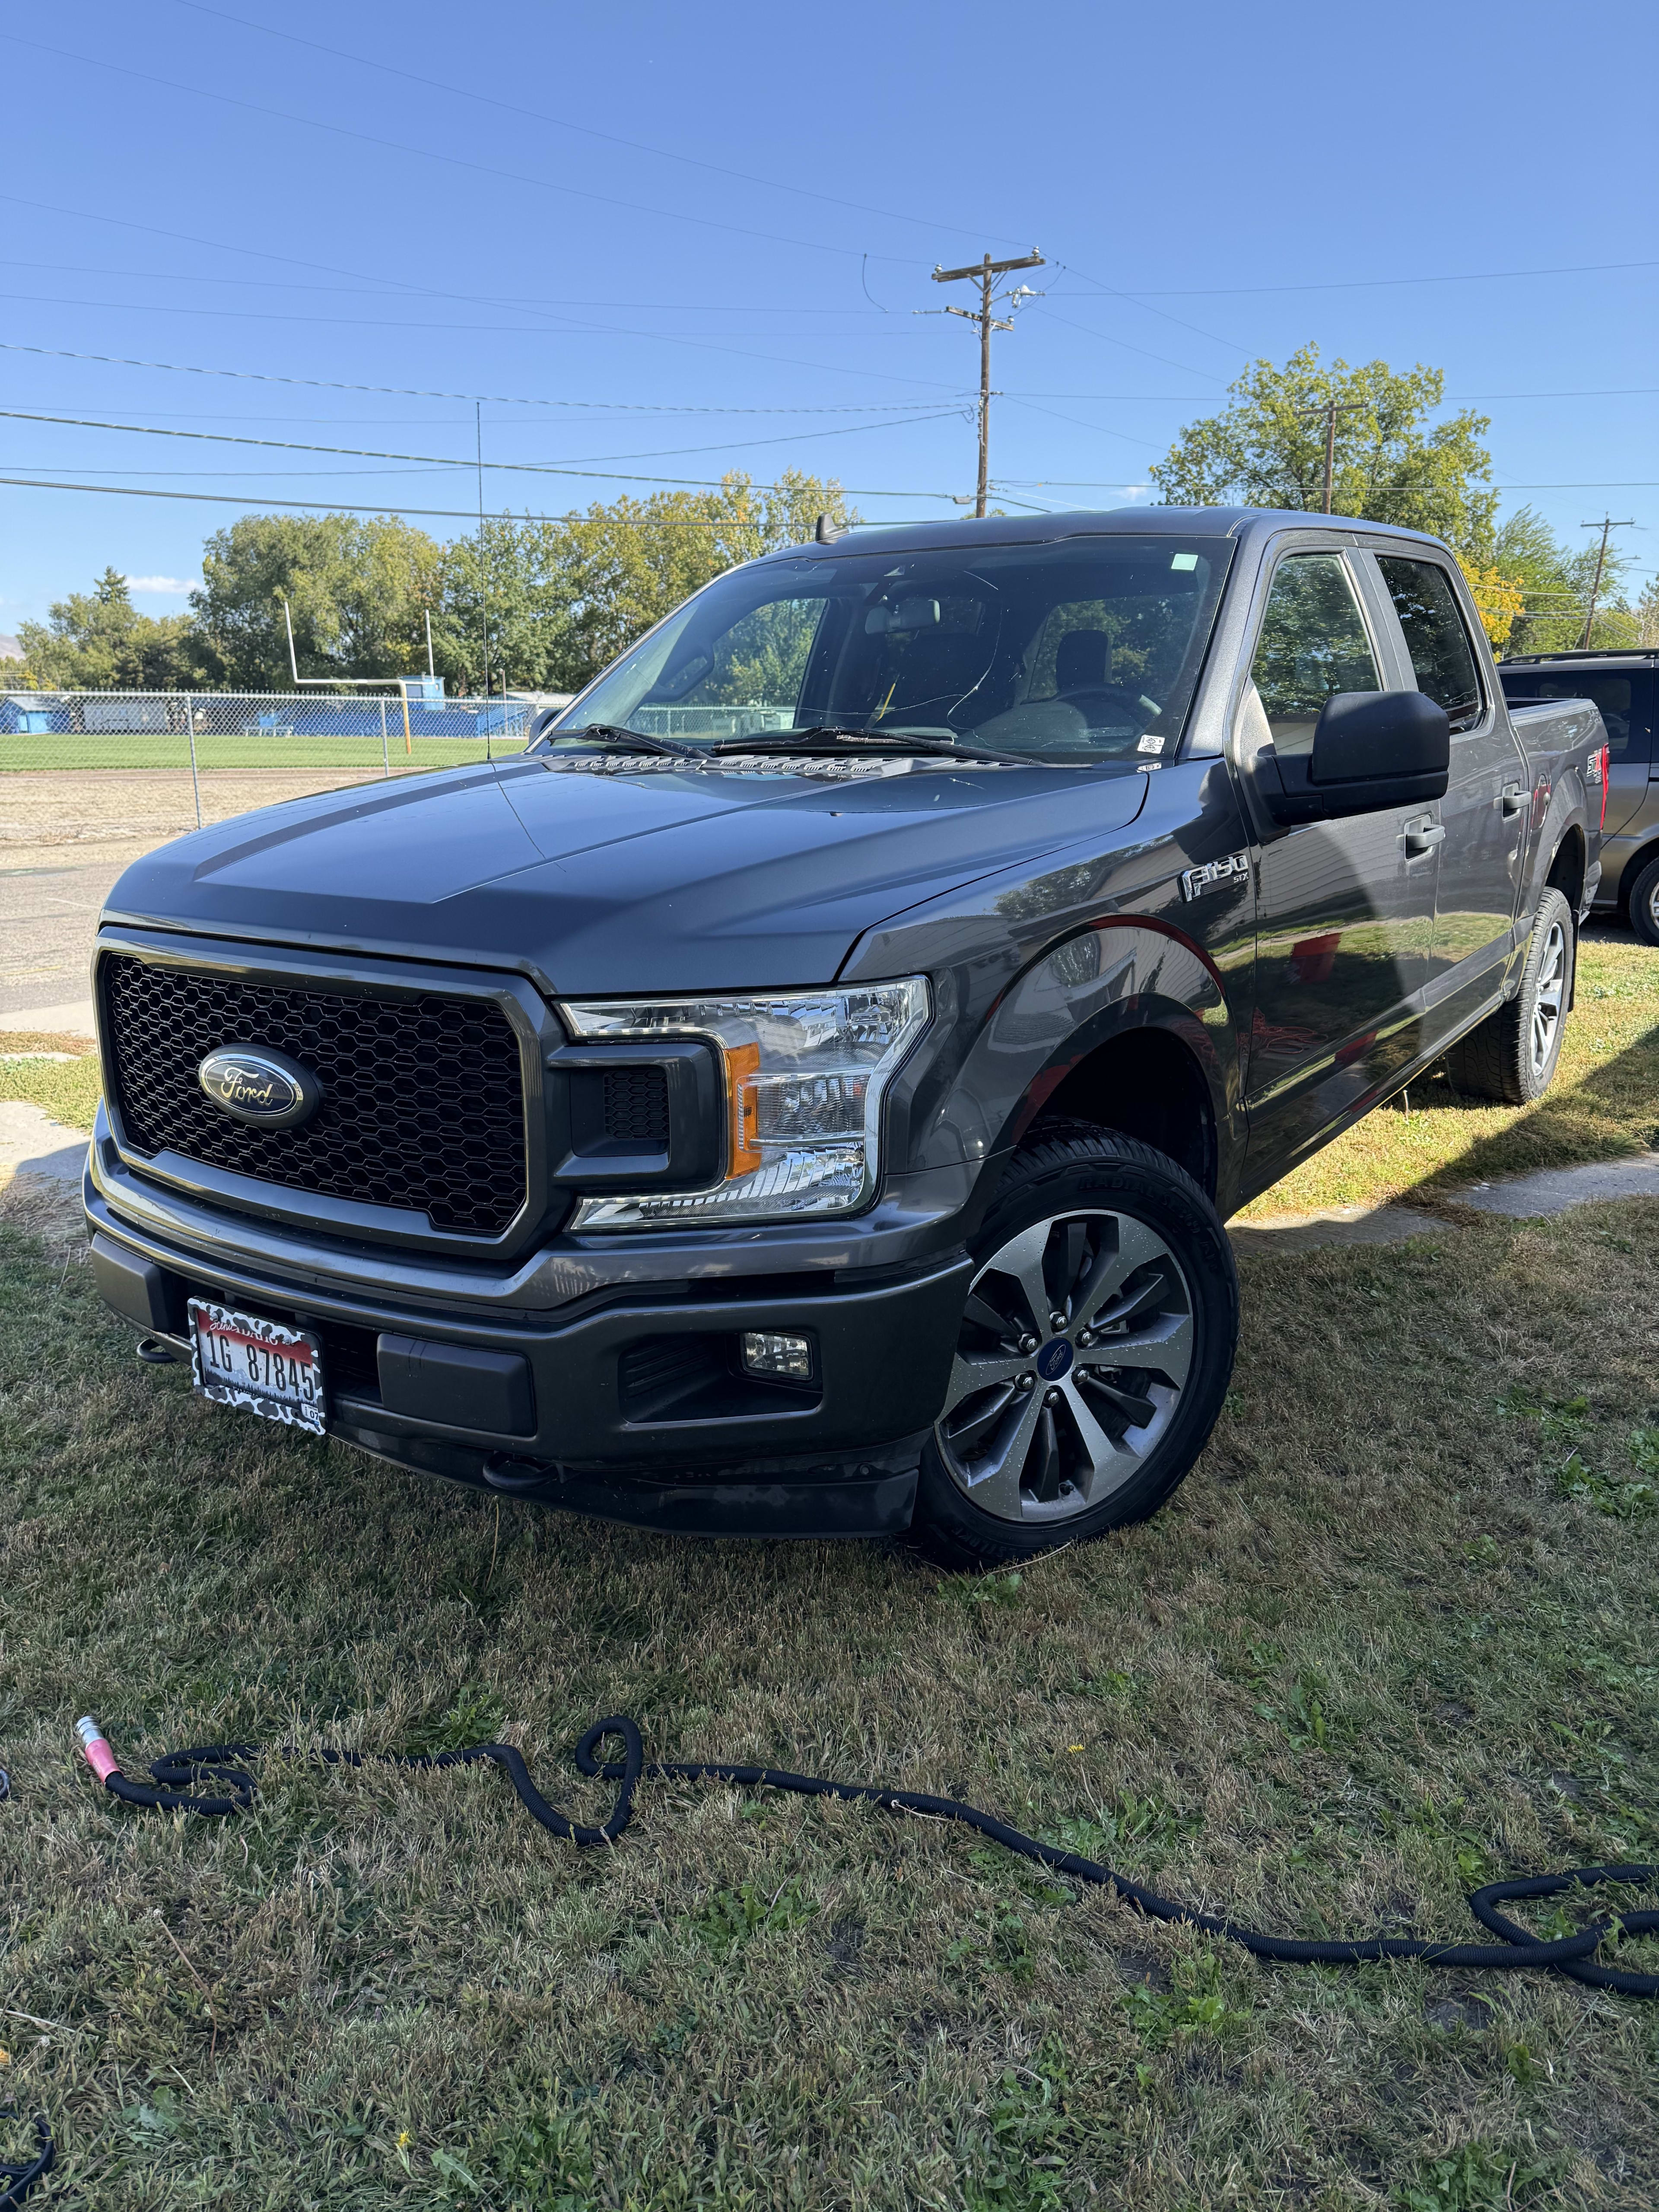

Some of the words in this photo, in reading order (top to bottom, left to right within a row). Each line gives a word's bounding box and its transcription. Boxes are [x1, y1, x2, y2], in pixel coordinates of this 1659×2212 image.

[1233, 872, 1249, 884] STX
[220, 1067, 273, 1106] Ford
[206, 1330, 232, 1373] 1G
[246, 1344, 315, 1401] 87845
[1049, 1350, 1064, 1371] Ford
